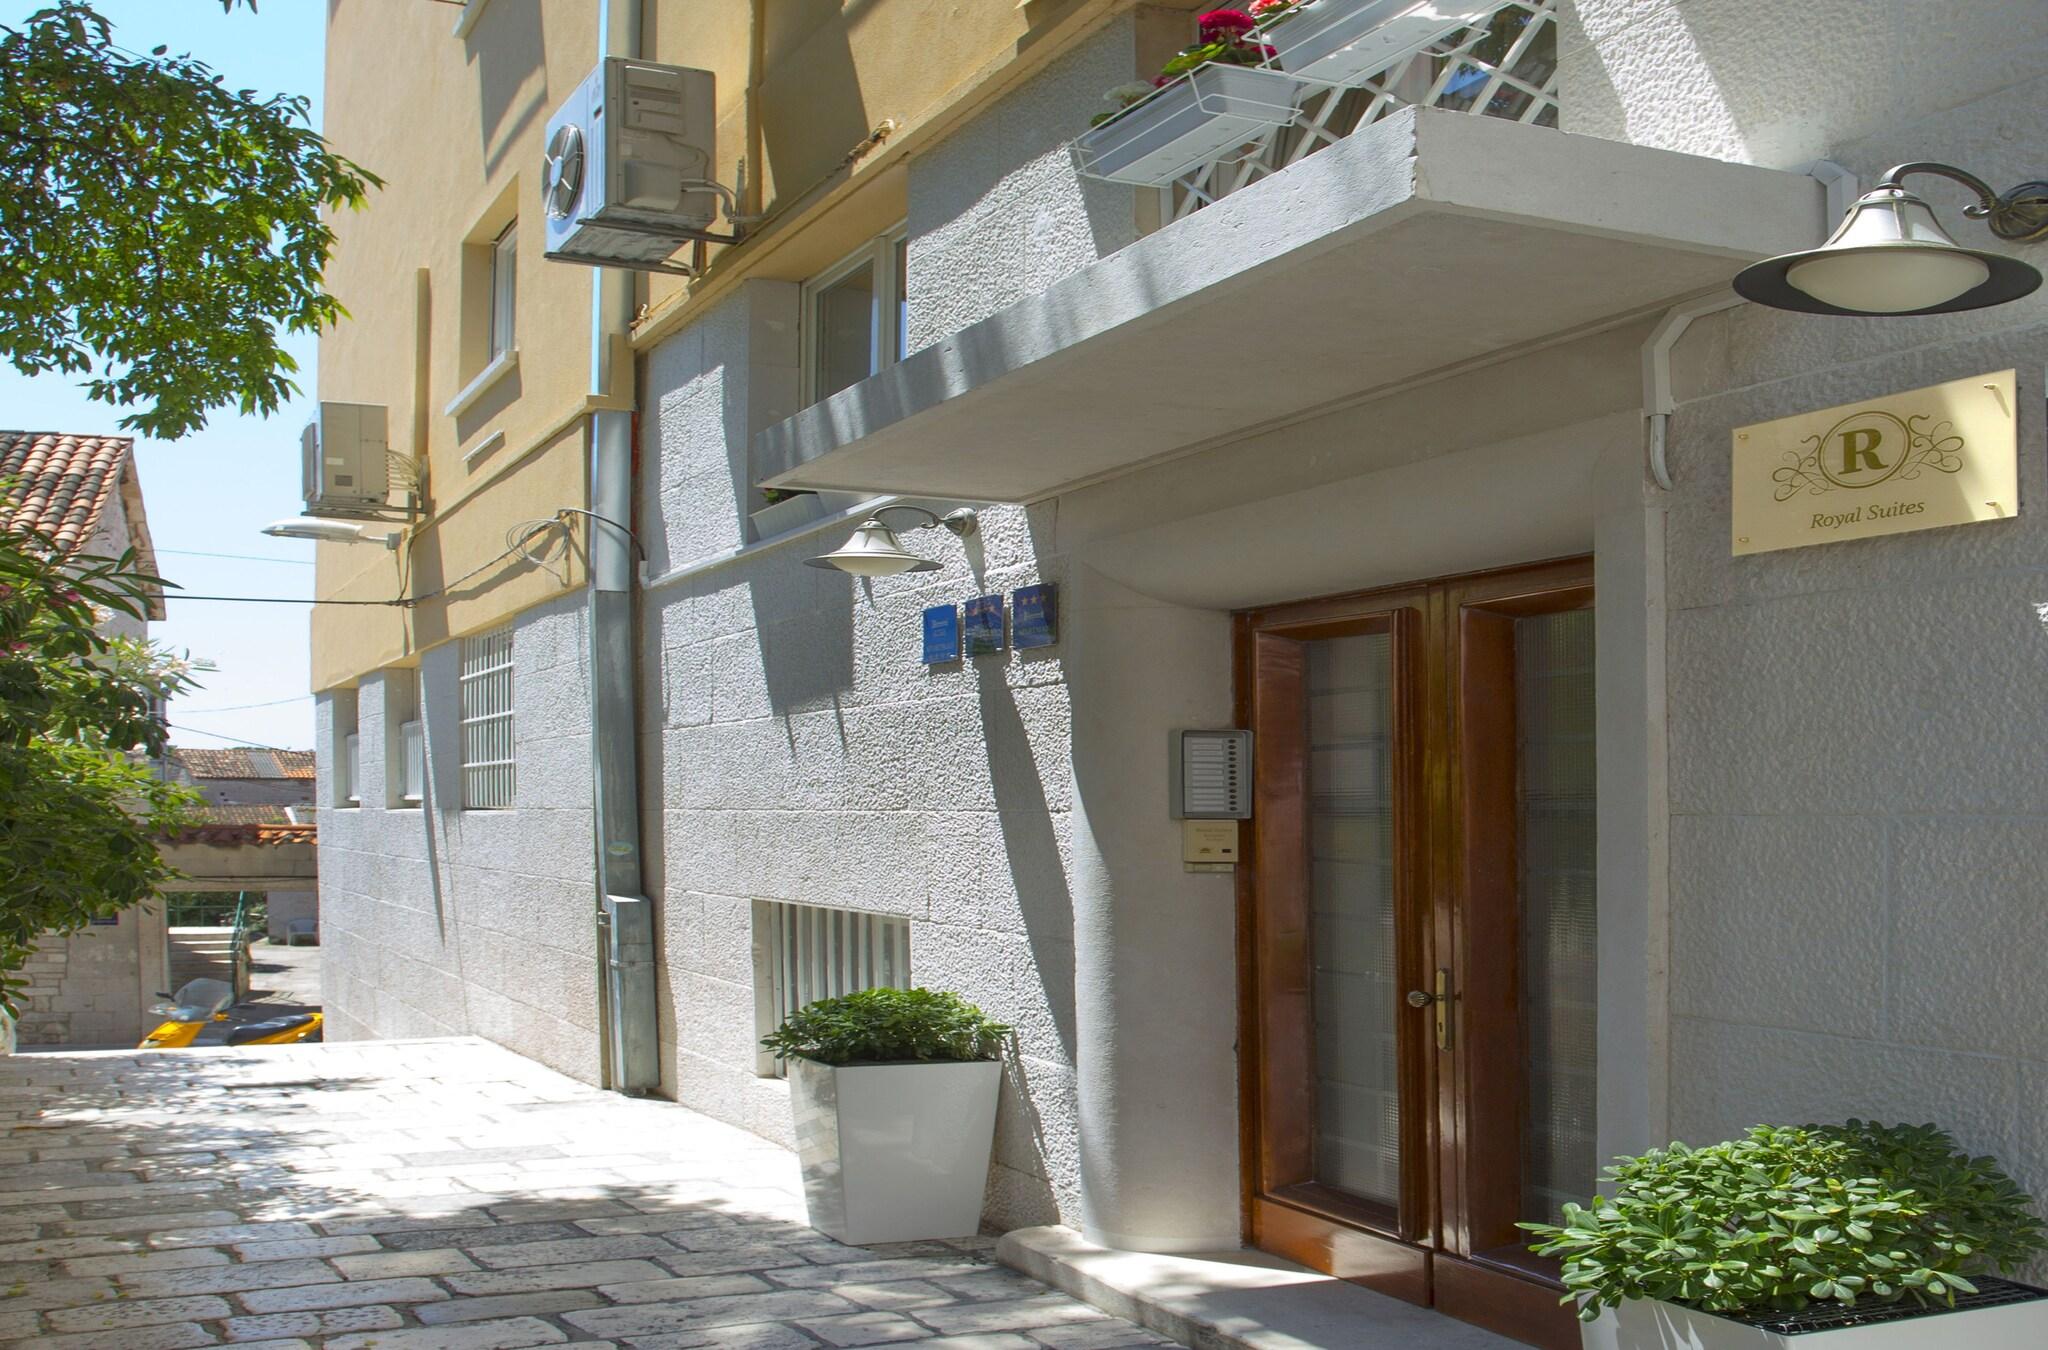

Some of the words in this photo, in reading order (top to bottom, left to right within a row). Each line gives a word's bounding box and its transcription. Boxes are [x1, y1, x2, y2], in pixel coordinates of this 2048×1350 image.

[1838, 428, 1888, 475] R
[1811, 507, 1861, 529] Royal
[1867, 501, 1925, 520] Suites
